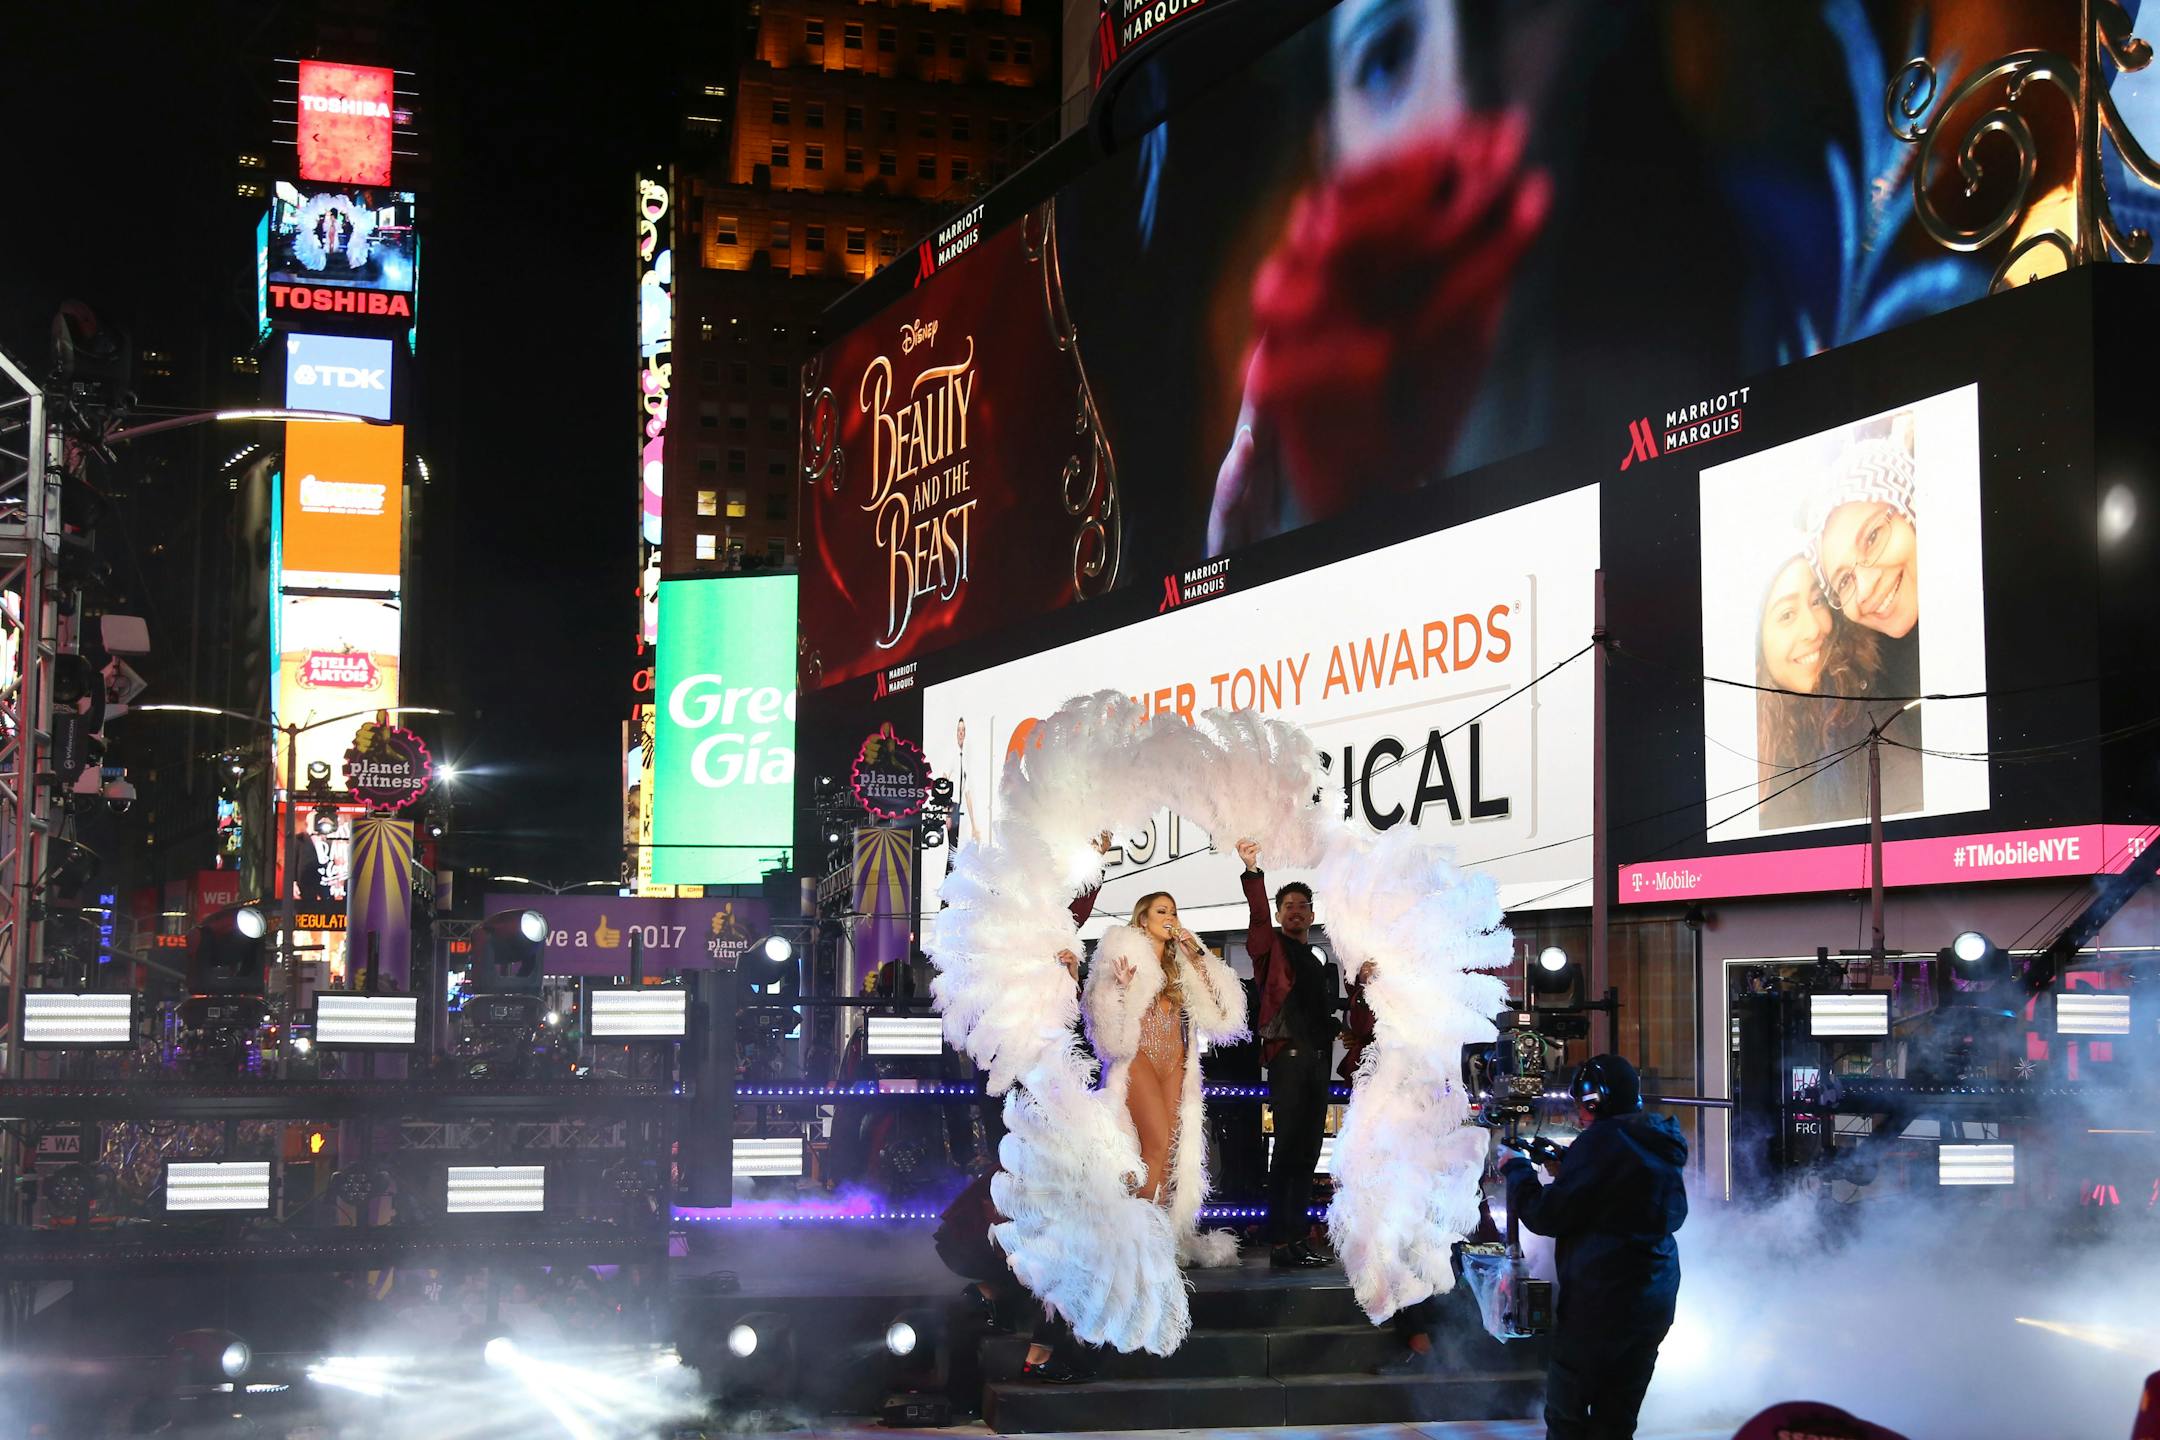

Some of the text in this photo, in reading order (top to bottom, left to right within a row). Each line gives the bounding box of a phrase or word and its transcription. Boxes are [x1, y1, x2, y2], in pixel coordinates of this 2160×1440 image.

[301, 96, 391, 118] TOSHIBA
[938, 204, 985, 247] MARRIOTT
[938, 228, 979, 267] MARQUIS
[270, 285, 411, 317] TOSHIBA
[315, 365, 385, 390] TDK
[1666, 386, 1750, 428] MARRIOTT
[1666, 413, 1740, 450] MARQUIS
[912, 459, 971, 515] AND THE
[876, 492, 978, 650] BEAST
[1184, 558, 1230, 584] MARRIOTT
[1184, 577, 1225, 600] MARQUIS
[310, 656, 369, 671] STELLA
[888, 662, 918, 680] MARRIOTT
[309, 668, 369, 684] ARTOIS
[888, 676, 914, 693] MARQUIS
[1210, 653, 1310, 713] TONY
[350, 759, 410, 777] planet
[860, 770, 914, 787] planet
[358, 773, 422, 789] fitness
[867, 784, 925, 798] fitness
[1953, 837, 2080, 868] #TMobileNYE
[295, 914, 347, 929] REGULAT
[575, 929, 588, 947] a
[707, 938, 748, 951] planet
[55, 1137, 80, 1151] WA
